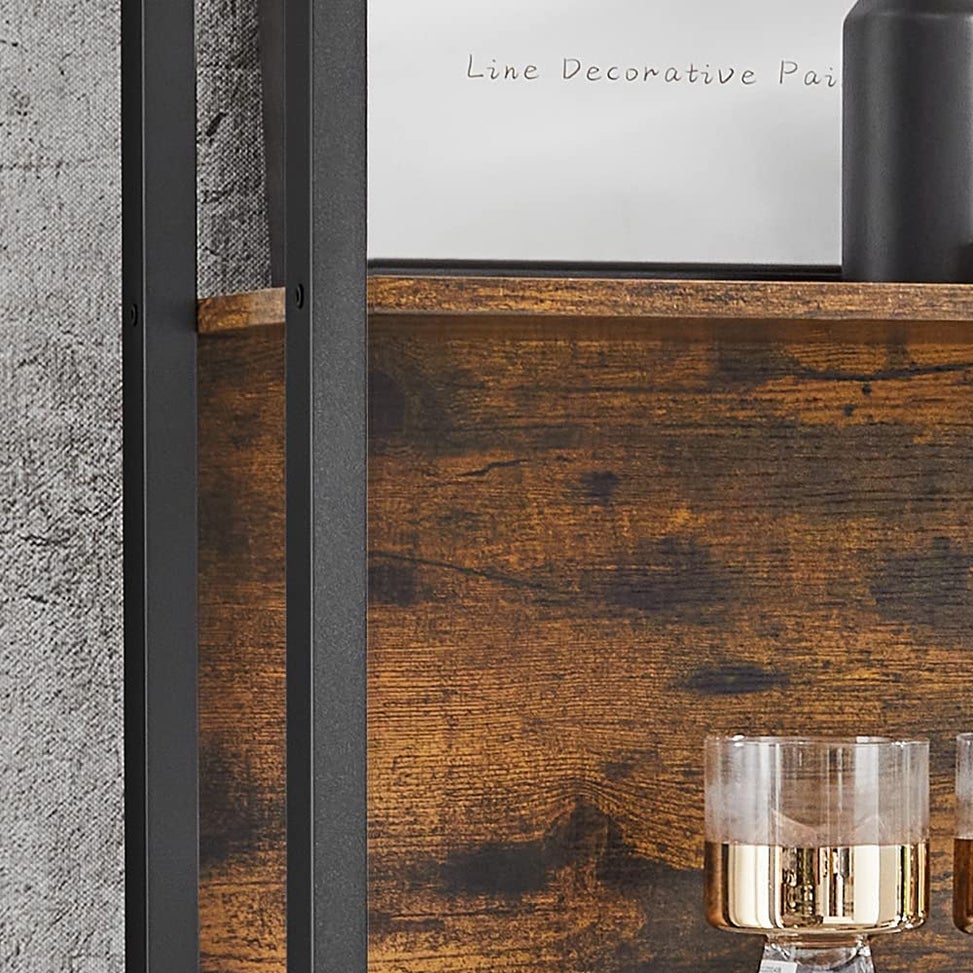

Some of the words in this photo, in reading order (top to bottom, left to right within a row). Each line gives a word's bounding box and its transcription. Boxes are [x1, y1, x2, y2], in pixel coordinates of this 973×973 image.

[467, 54, 540, 80] Line
[563, 58, 757, 85] Decorative
[779, 60, 838, 88] Pai
